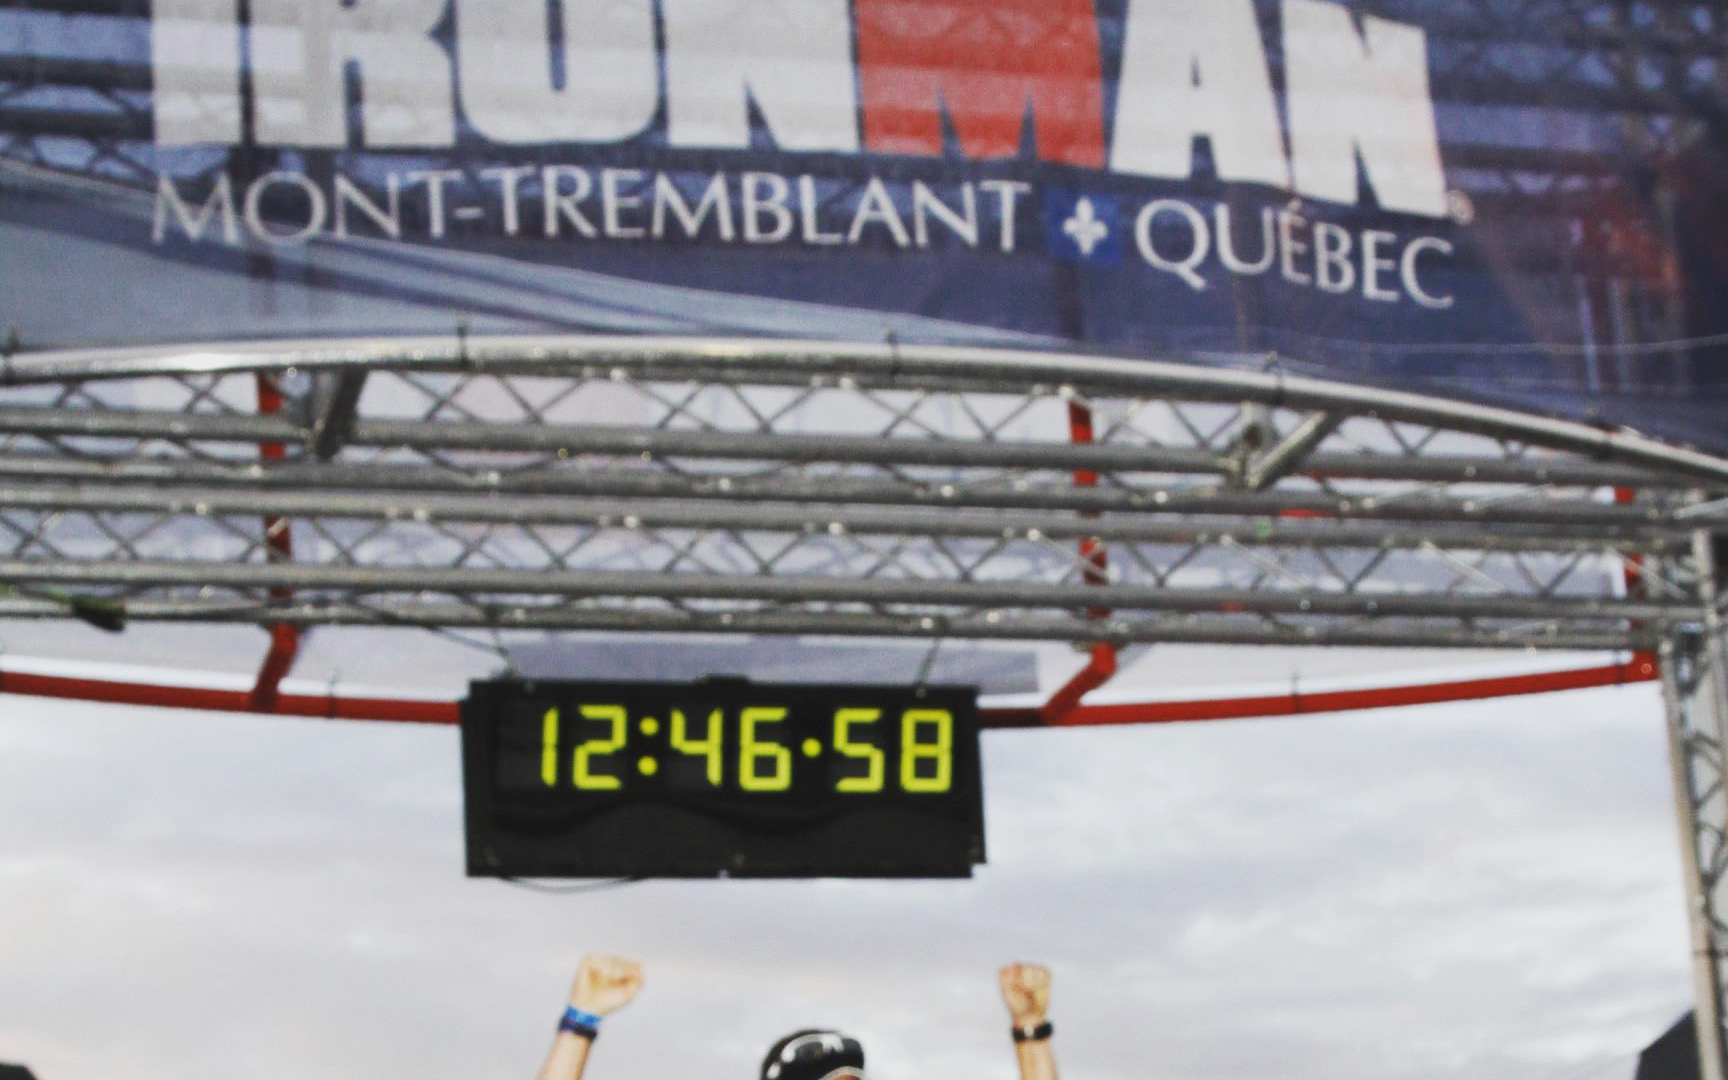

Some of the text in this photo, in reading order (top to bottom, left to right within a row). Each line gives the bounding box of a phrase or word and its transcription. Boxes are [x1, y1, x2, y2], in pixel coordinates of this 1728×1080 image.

[151, 0, 1448, 217] IRONMAN
[152, 164, 1455, 309] MONT-TREMBLANT QUÉBEC
